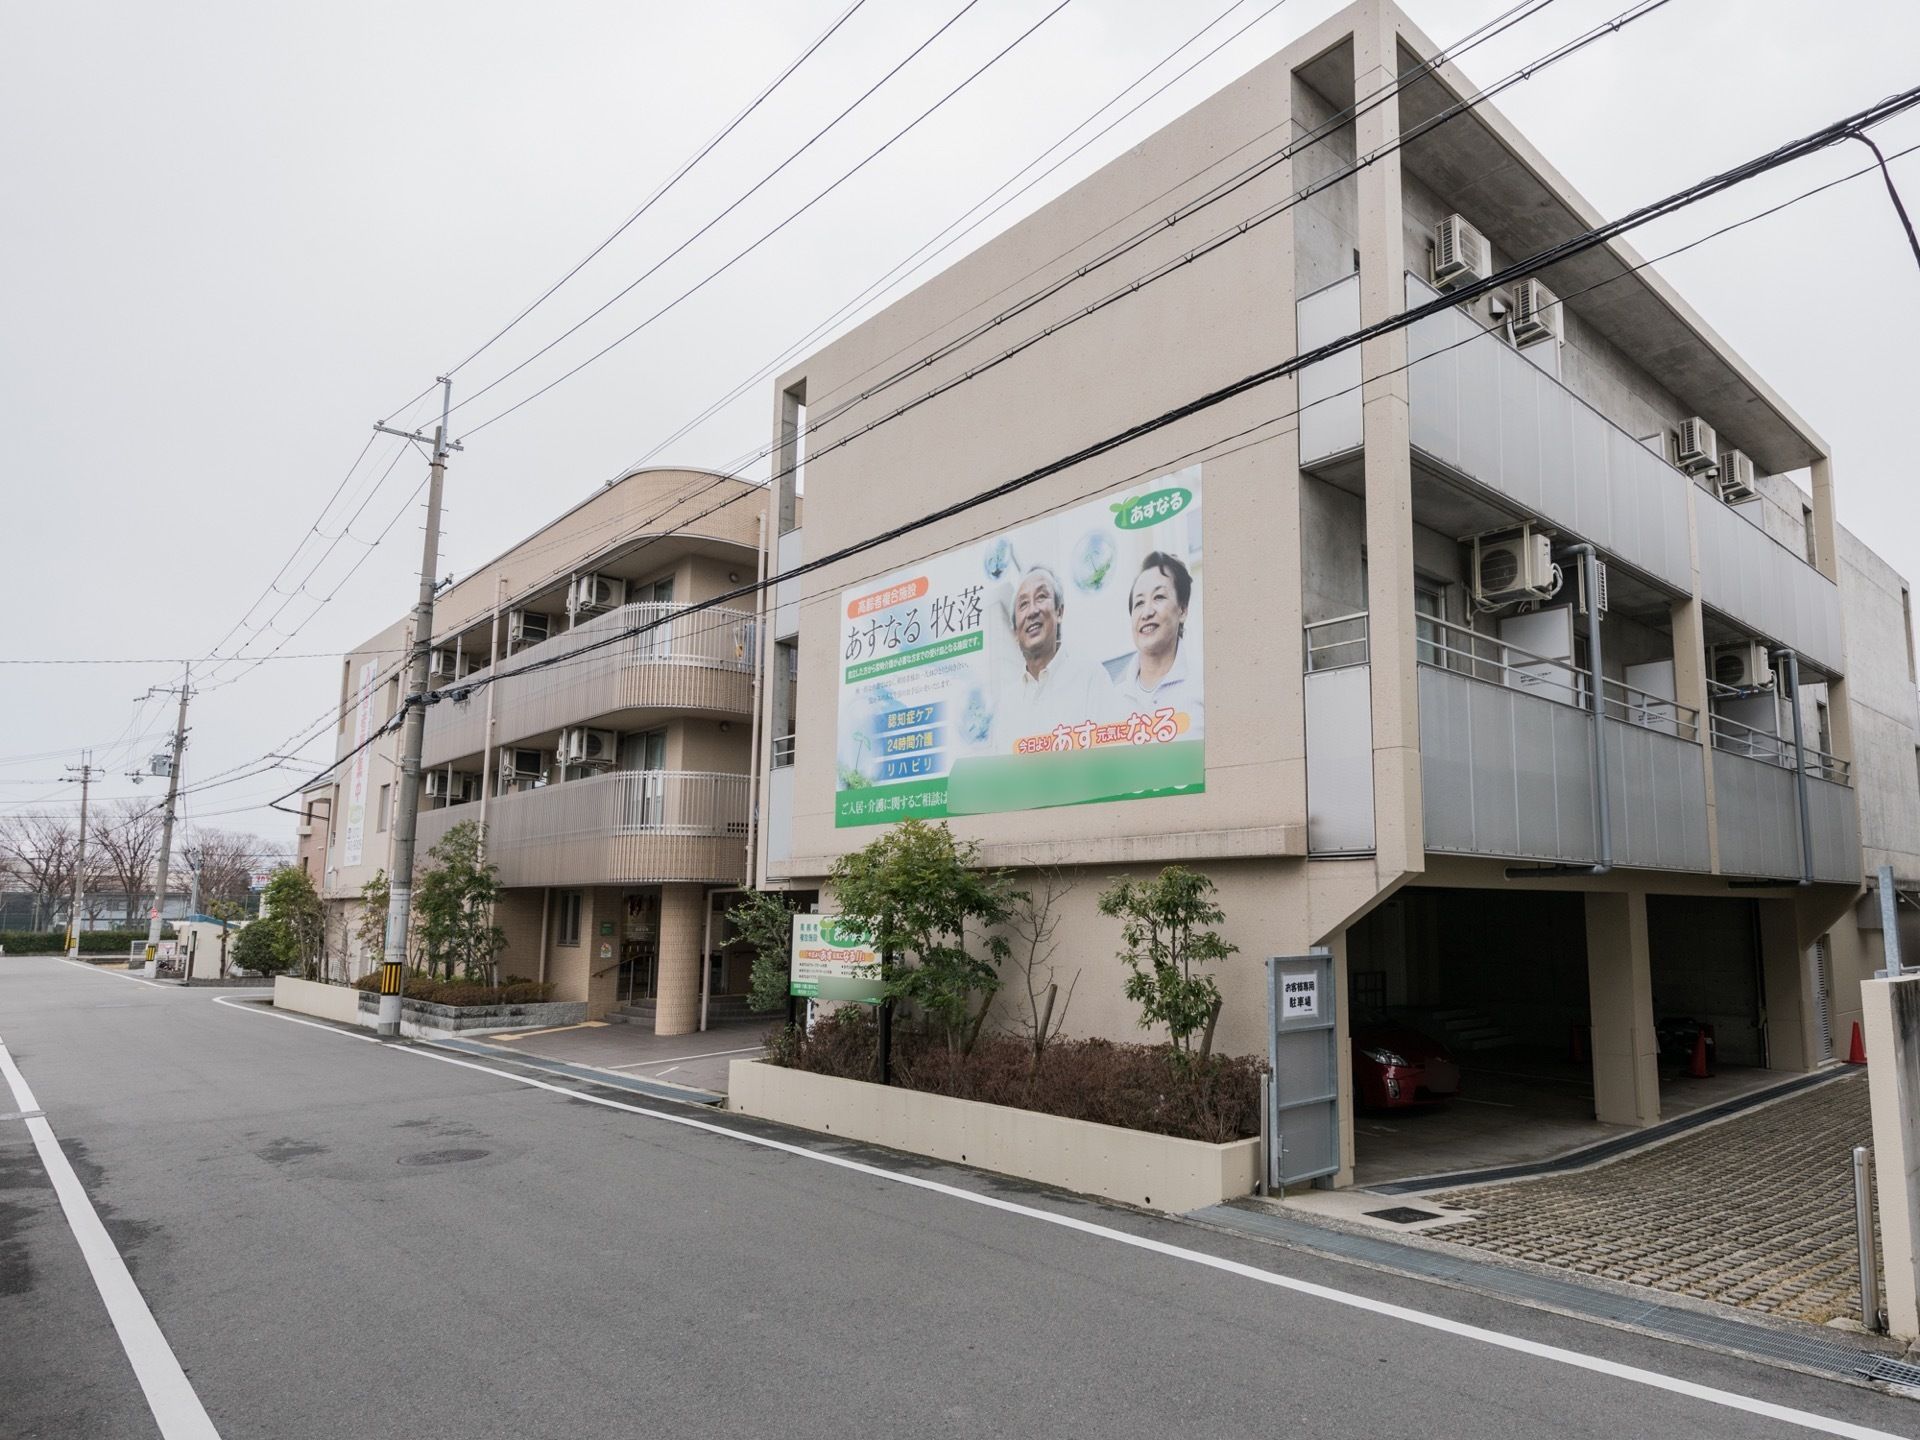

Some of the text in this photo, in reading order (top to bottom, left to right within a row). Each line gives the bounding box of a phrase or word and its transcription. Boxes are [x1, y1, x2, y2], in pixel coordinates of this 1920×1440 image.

[1130, 491, 1184, 524] あすなる
[845, 585, 984, 660] あすなる 牧落
[887, 706, 934, 729] 認知症ケア
[1019, 707, 1178, 754] 今日よりあす元気になる
[887, 731, 934, 753] 24時間介護
[888, 757, 932, 777] リハビリ
[1285, 981, 1315, 992] お客様専用
[1289, 996, 1311, 1008] 駐車場
